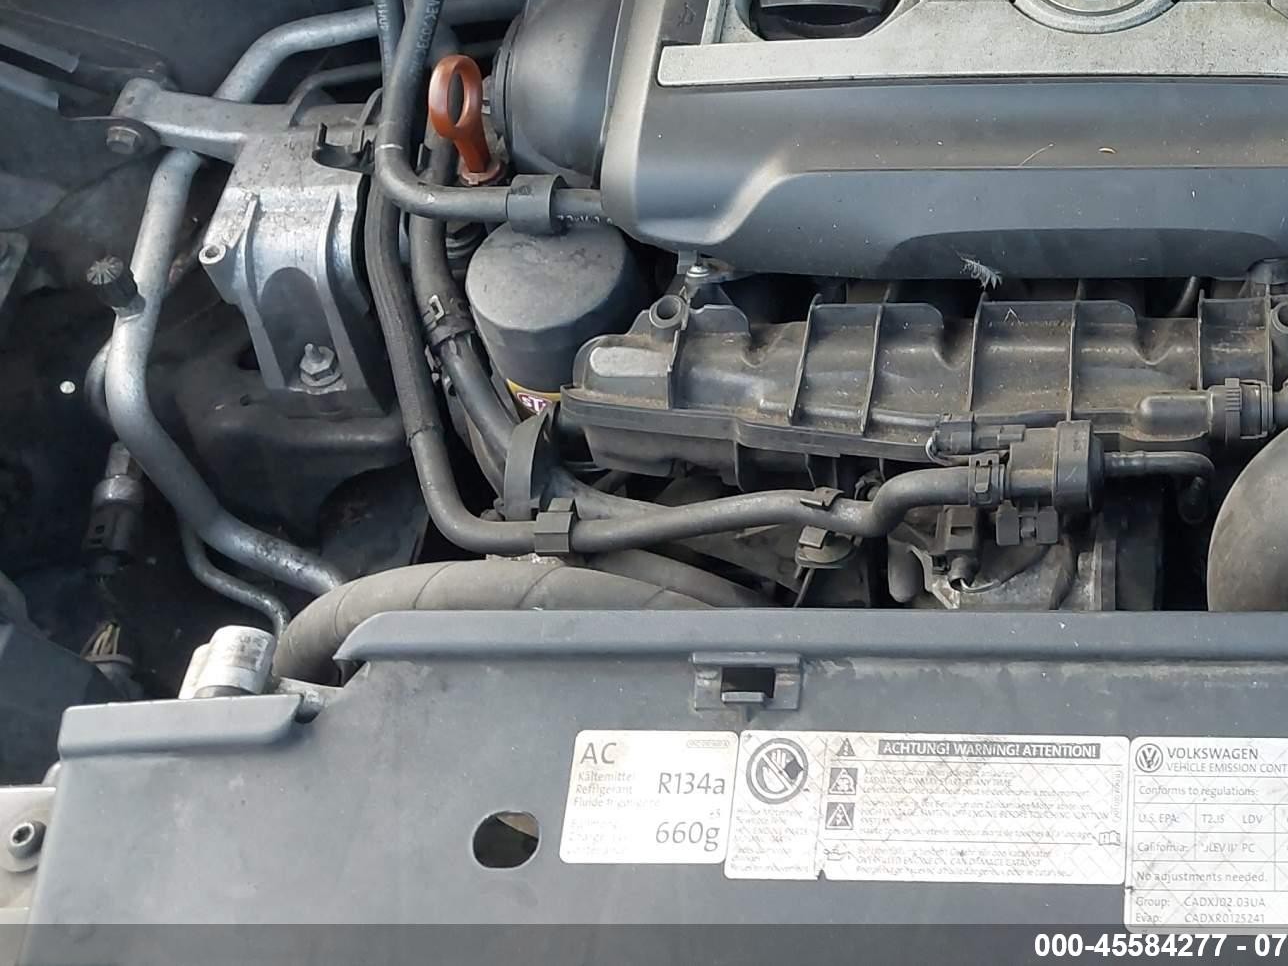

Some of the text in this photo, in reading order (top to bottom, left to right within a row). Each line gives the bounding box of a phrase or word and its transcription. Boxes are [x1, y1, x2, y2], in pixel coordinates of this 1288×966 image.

[580, 742, 617, 764] AC
[883, 742, 1097, 757] ACHTUNG! WARNING! ATTENTION!
[1167, 747, 1259, 760] VOLKSWAGEN
[1167, 762, 1206, 772] VEHICLE
[1209, 763, 1256, 773] EMISSION
[658, 772, 726, 794] R134a
[1139, 785, 1186, 795] Conforms
[1188, 786, 1198, 795] to
[1243, 814, 1264, 824] LDV
[656, 821, 721, 852] 660g
[1242, 843, 1256, 852] PC
[1136, 871, 1151, 881] No
[1155, 871, 1222, 883] adjustments
[1136, 897, 1170, 909] Group:
[1136, 912, 1163, 924] Evap:
